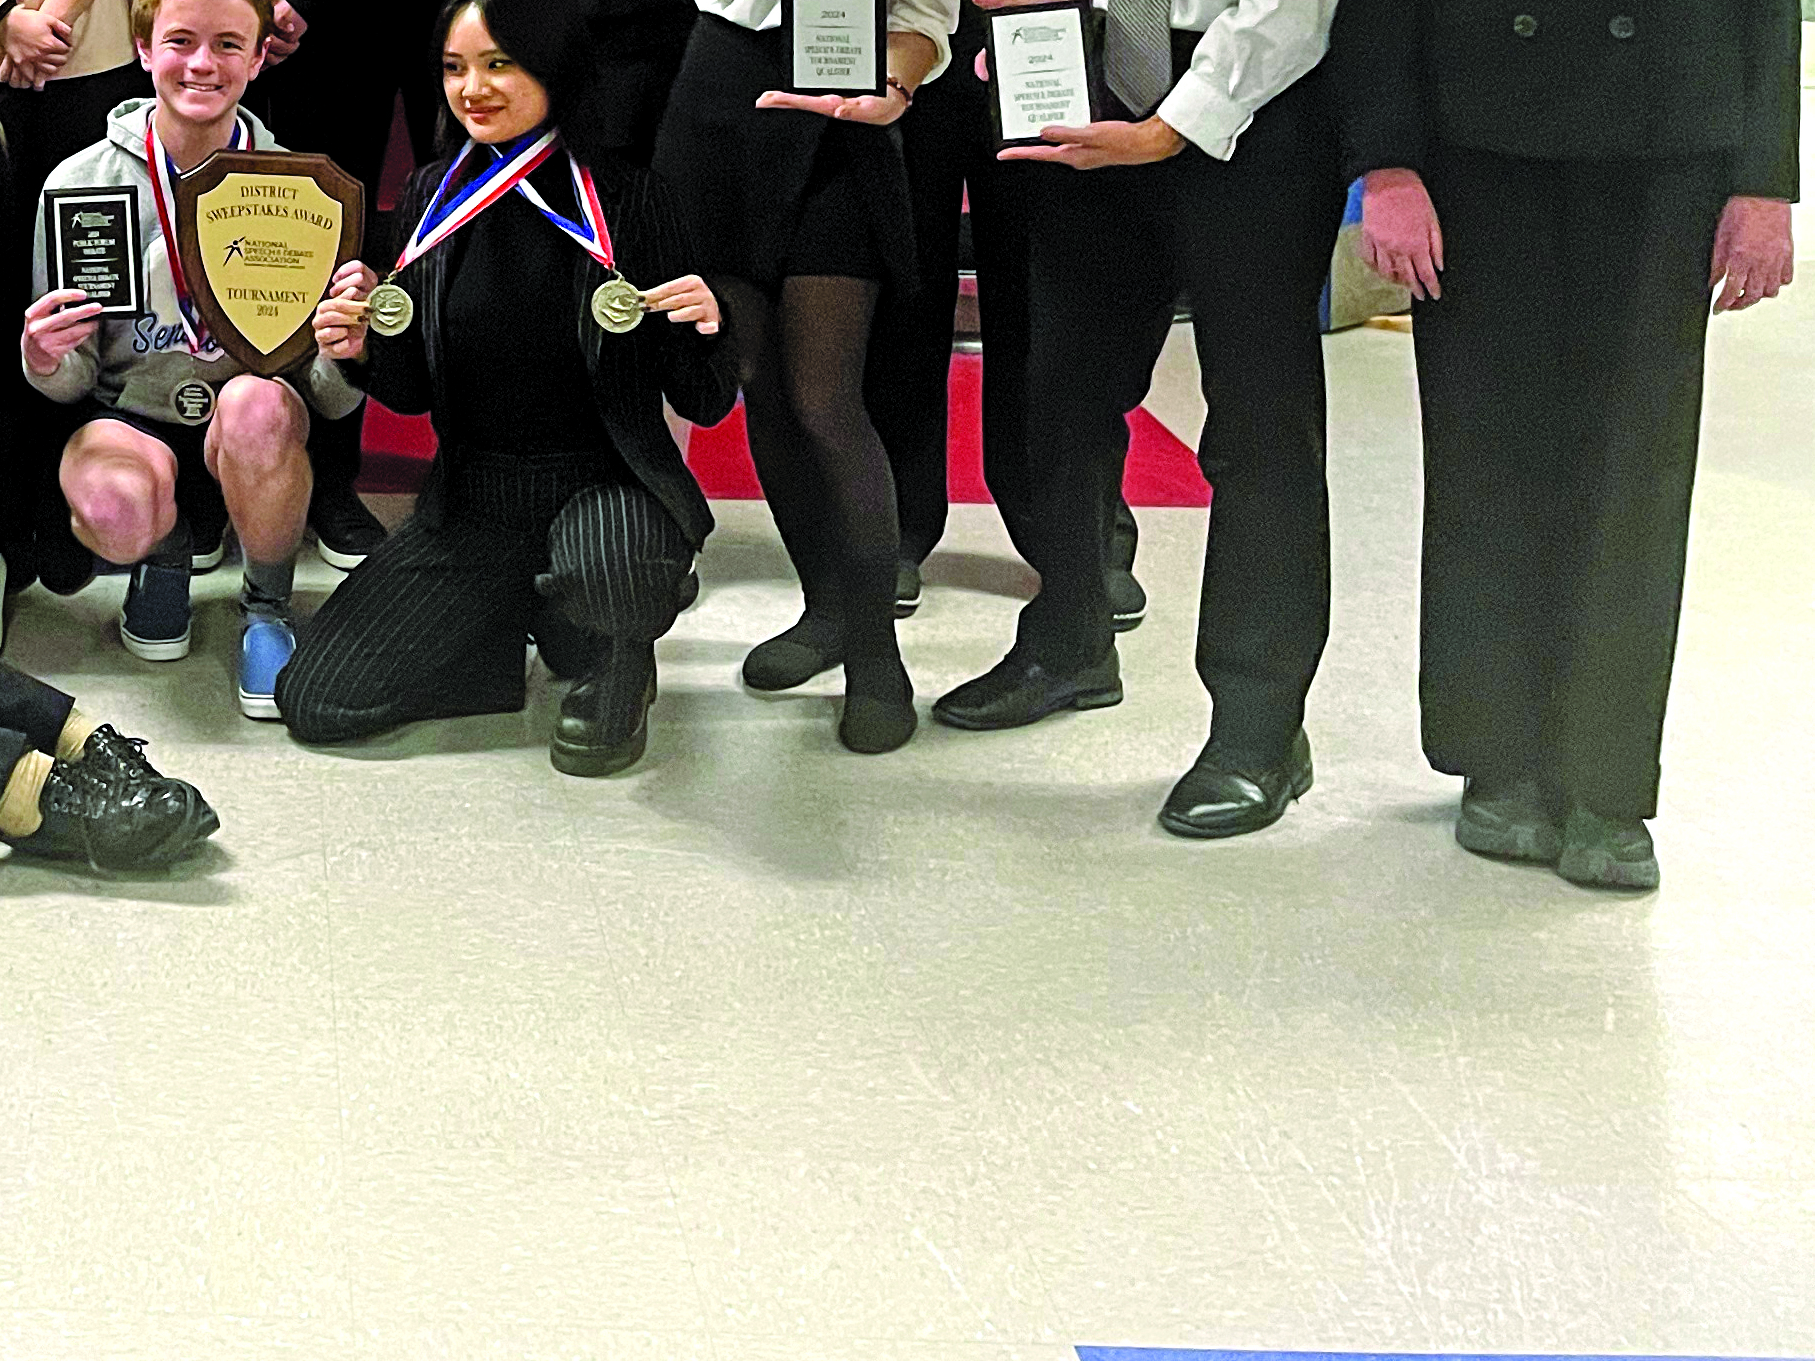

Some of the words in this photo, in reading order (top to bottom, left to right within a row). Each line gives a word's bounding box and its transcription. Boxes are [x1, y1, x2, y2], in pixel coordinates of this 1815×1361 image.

[241, 185, 298, 199] DISTRICT
[206, 204, 289, 224] SWEEPSTAKES
[292, 208, 333, 230] AWARD
[244, 239, 288, 248] NATIONAL
[244, 255, 300, 264] ASSOCIATION
[226, 287, 308, 303] TOURNAMENT
[257, 304, 278, 317] 2024
